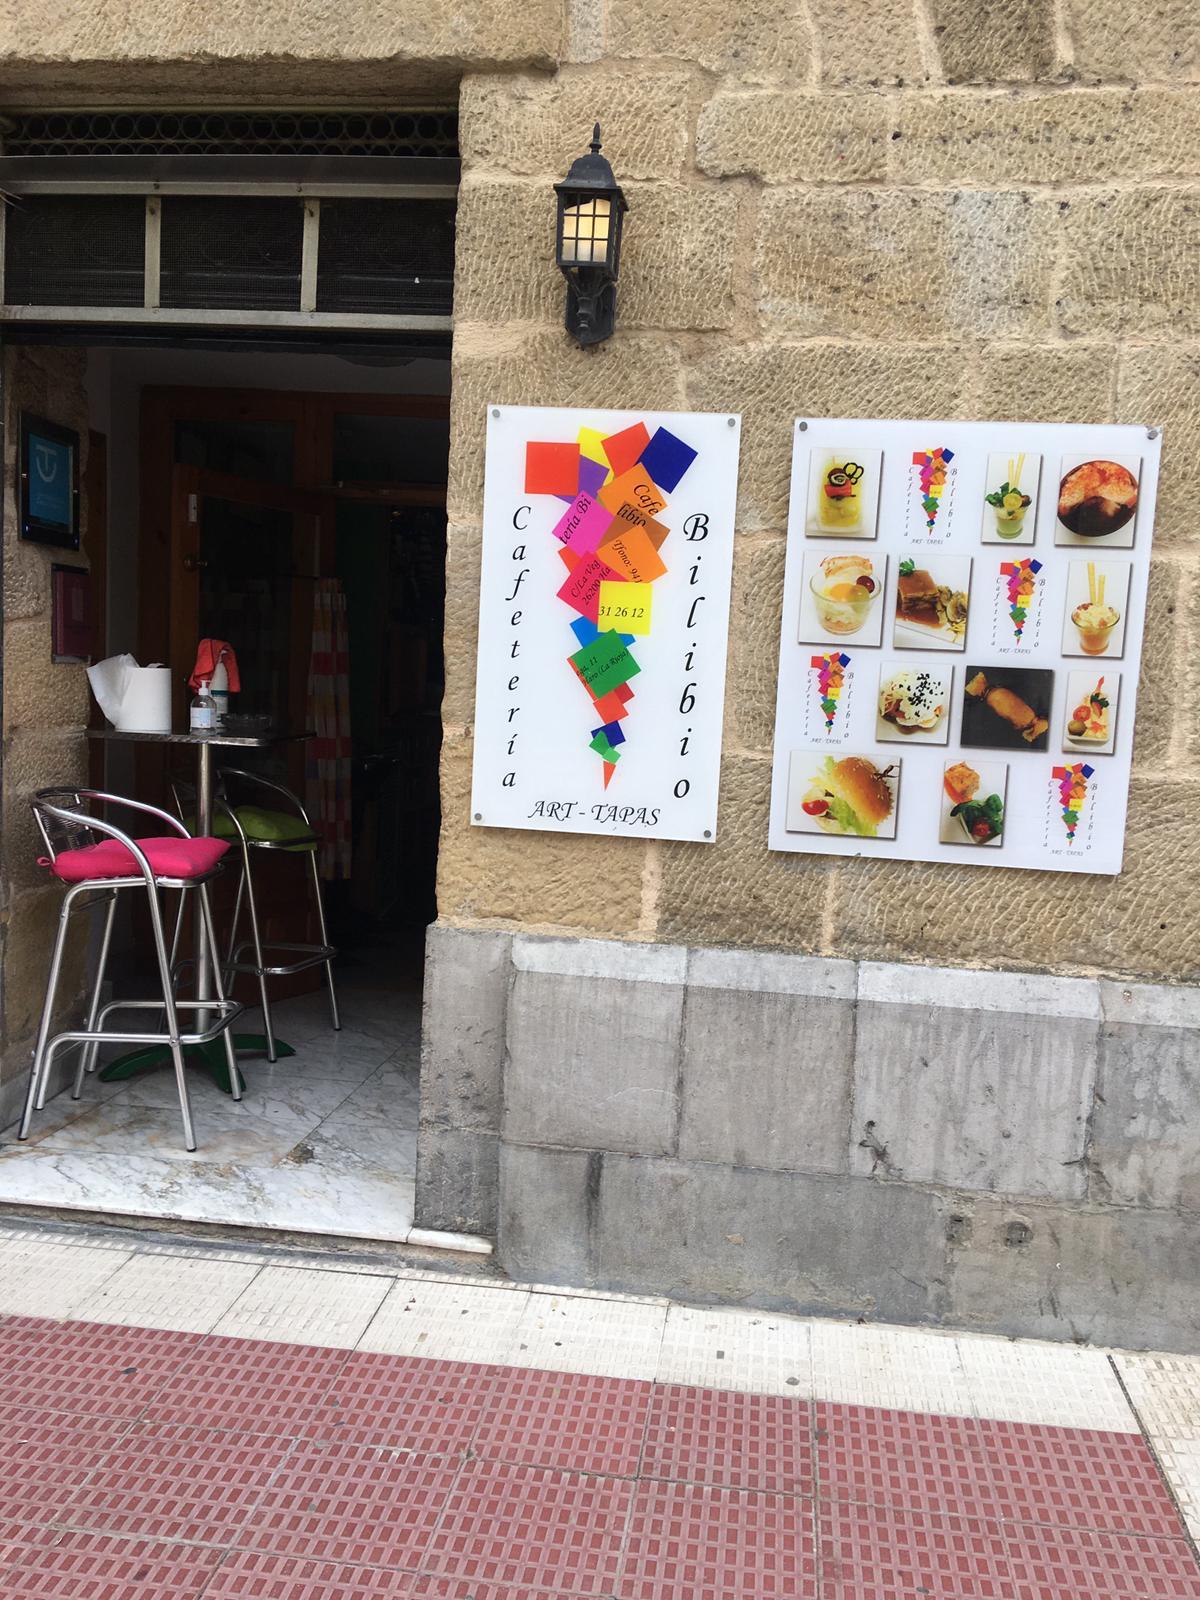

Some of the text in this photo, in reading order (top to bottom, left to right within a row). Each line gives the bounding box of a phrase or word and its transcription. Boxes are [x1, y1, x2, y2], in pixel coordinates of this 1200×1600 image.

[576, 494, 592, 514] Bi
[633, 484, 662, 516] Cafe
[598, 606, 644, 618] 31 26 12
[502, 505, 531, 787] Cafetería
[673, 513, 710, 798] Bilibio
[528, 800, 578, 821] ART
[591, 803, 661, 825] TAPAS
